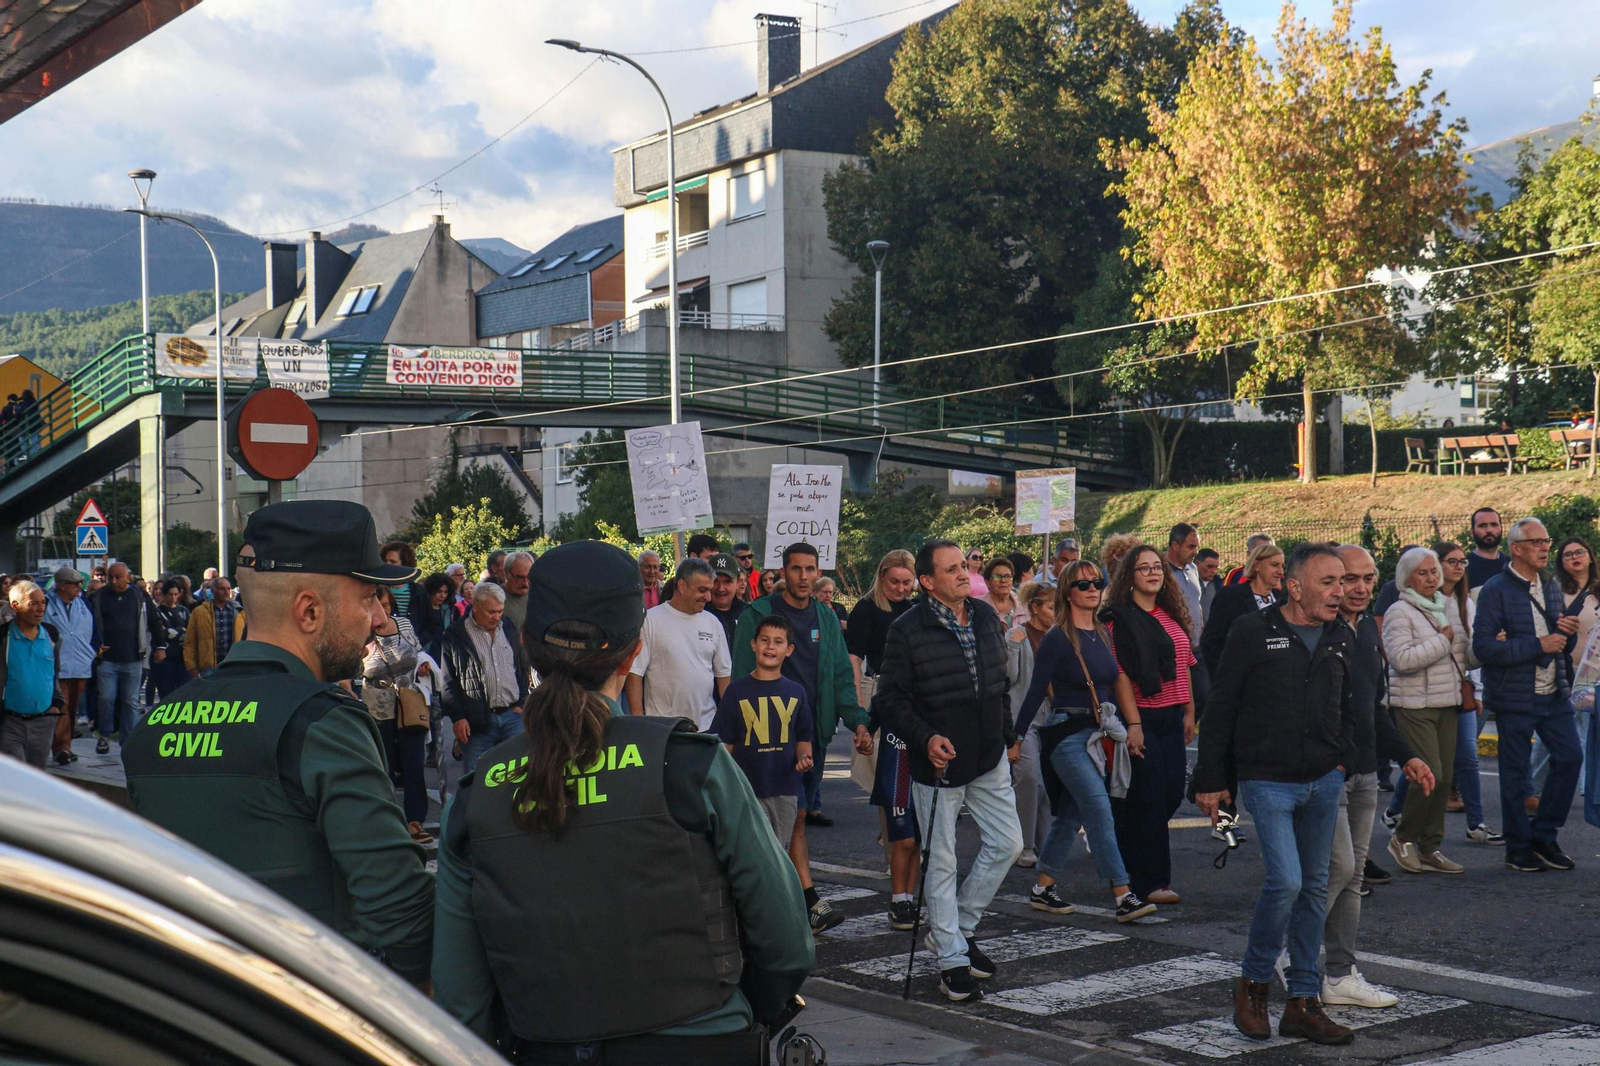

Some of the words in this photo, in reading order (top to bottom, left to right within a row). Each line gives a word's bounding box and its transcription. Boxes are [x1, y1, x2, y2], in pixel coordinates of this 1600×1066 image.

[223, 345, 243, 356] Ruta
[262, 344, 324, 357] QUEREMOS
[283, 359, 301, 373] UN
[392, 359, 412, 372] EN
[416, 361, 459, 373] LOITA
[462, 361, 493, 374] POR
[497, 363, 517, 375] UN
[395, 372, 474, 384] CONVENIO
[776, 519, 832, 537] COIDA
[544, 634, 569, 648] GUARDIA
[570, 641, 587, 649] CIVIL
[147, 700, 258, 726] GUARDIA
[739, 695, 799, 747] NY
[158, 732, 223, 758] CIVIL
